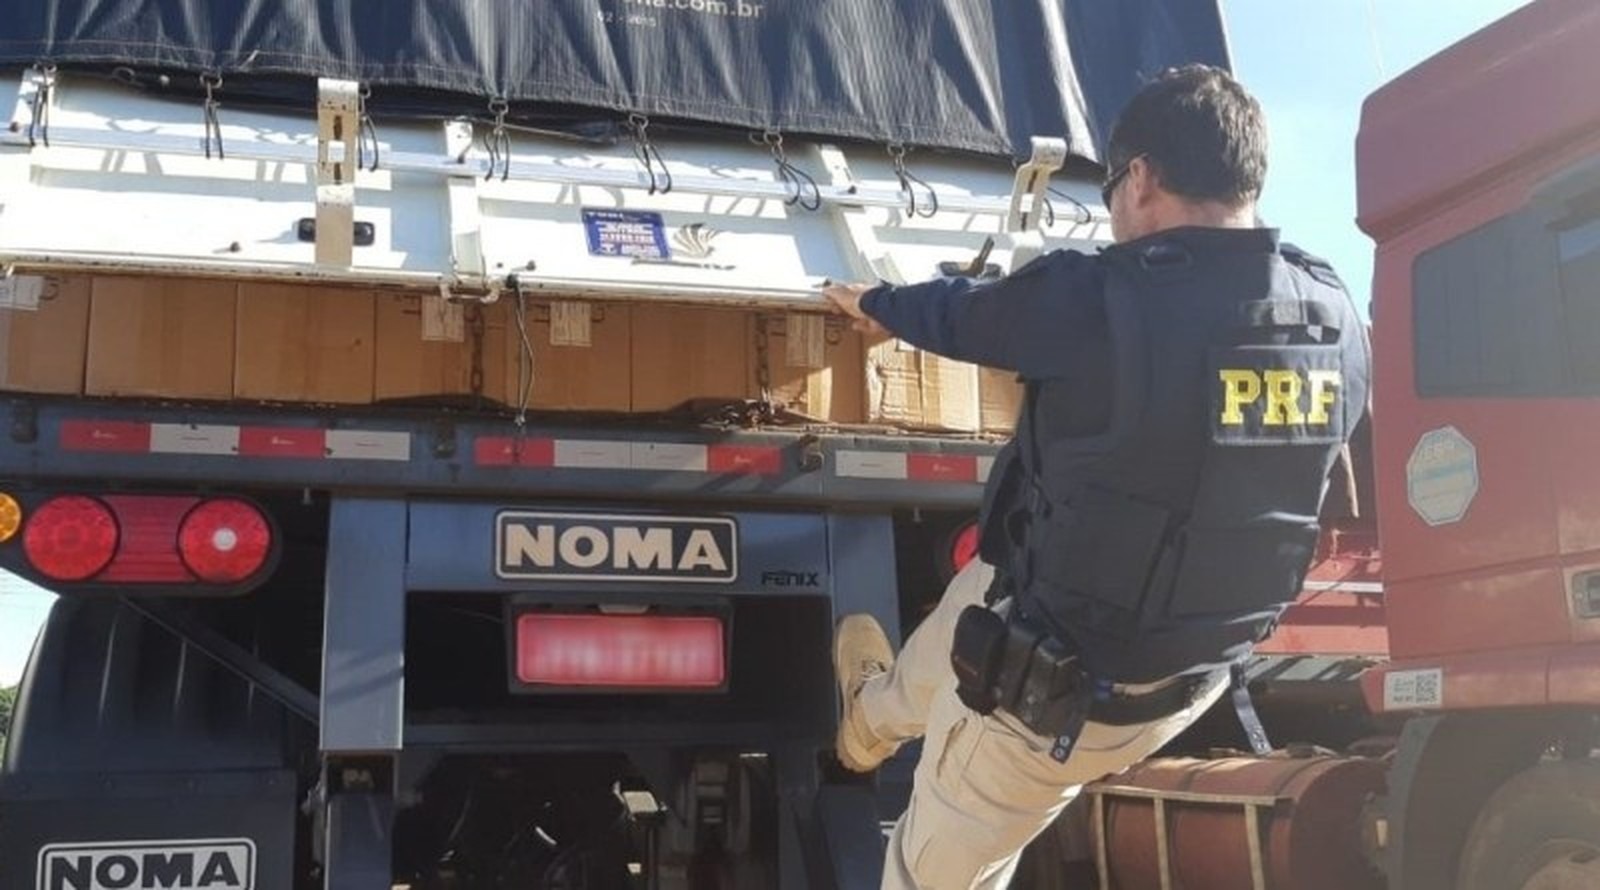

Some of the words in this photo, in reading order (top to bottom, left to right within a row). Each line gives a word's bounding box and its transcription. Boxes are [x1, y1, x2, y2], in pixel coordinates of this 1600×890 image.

[1219, 369, 1342, 425] PRF
[505, 524, 727, 571] NOMA
[51, 851, 240, 890] NOMA
